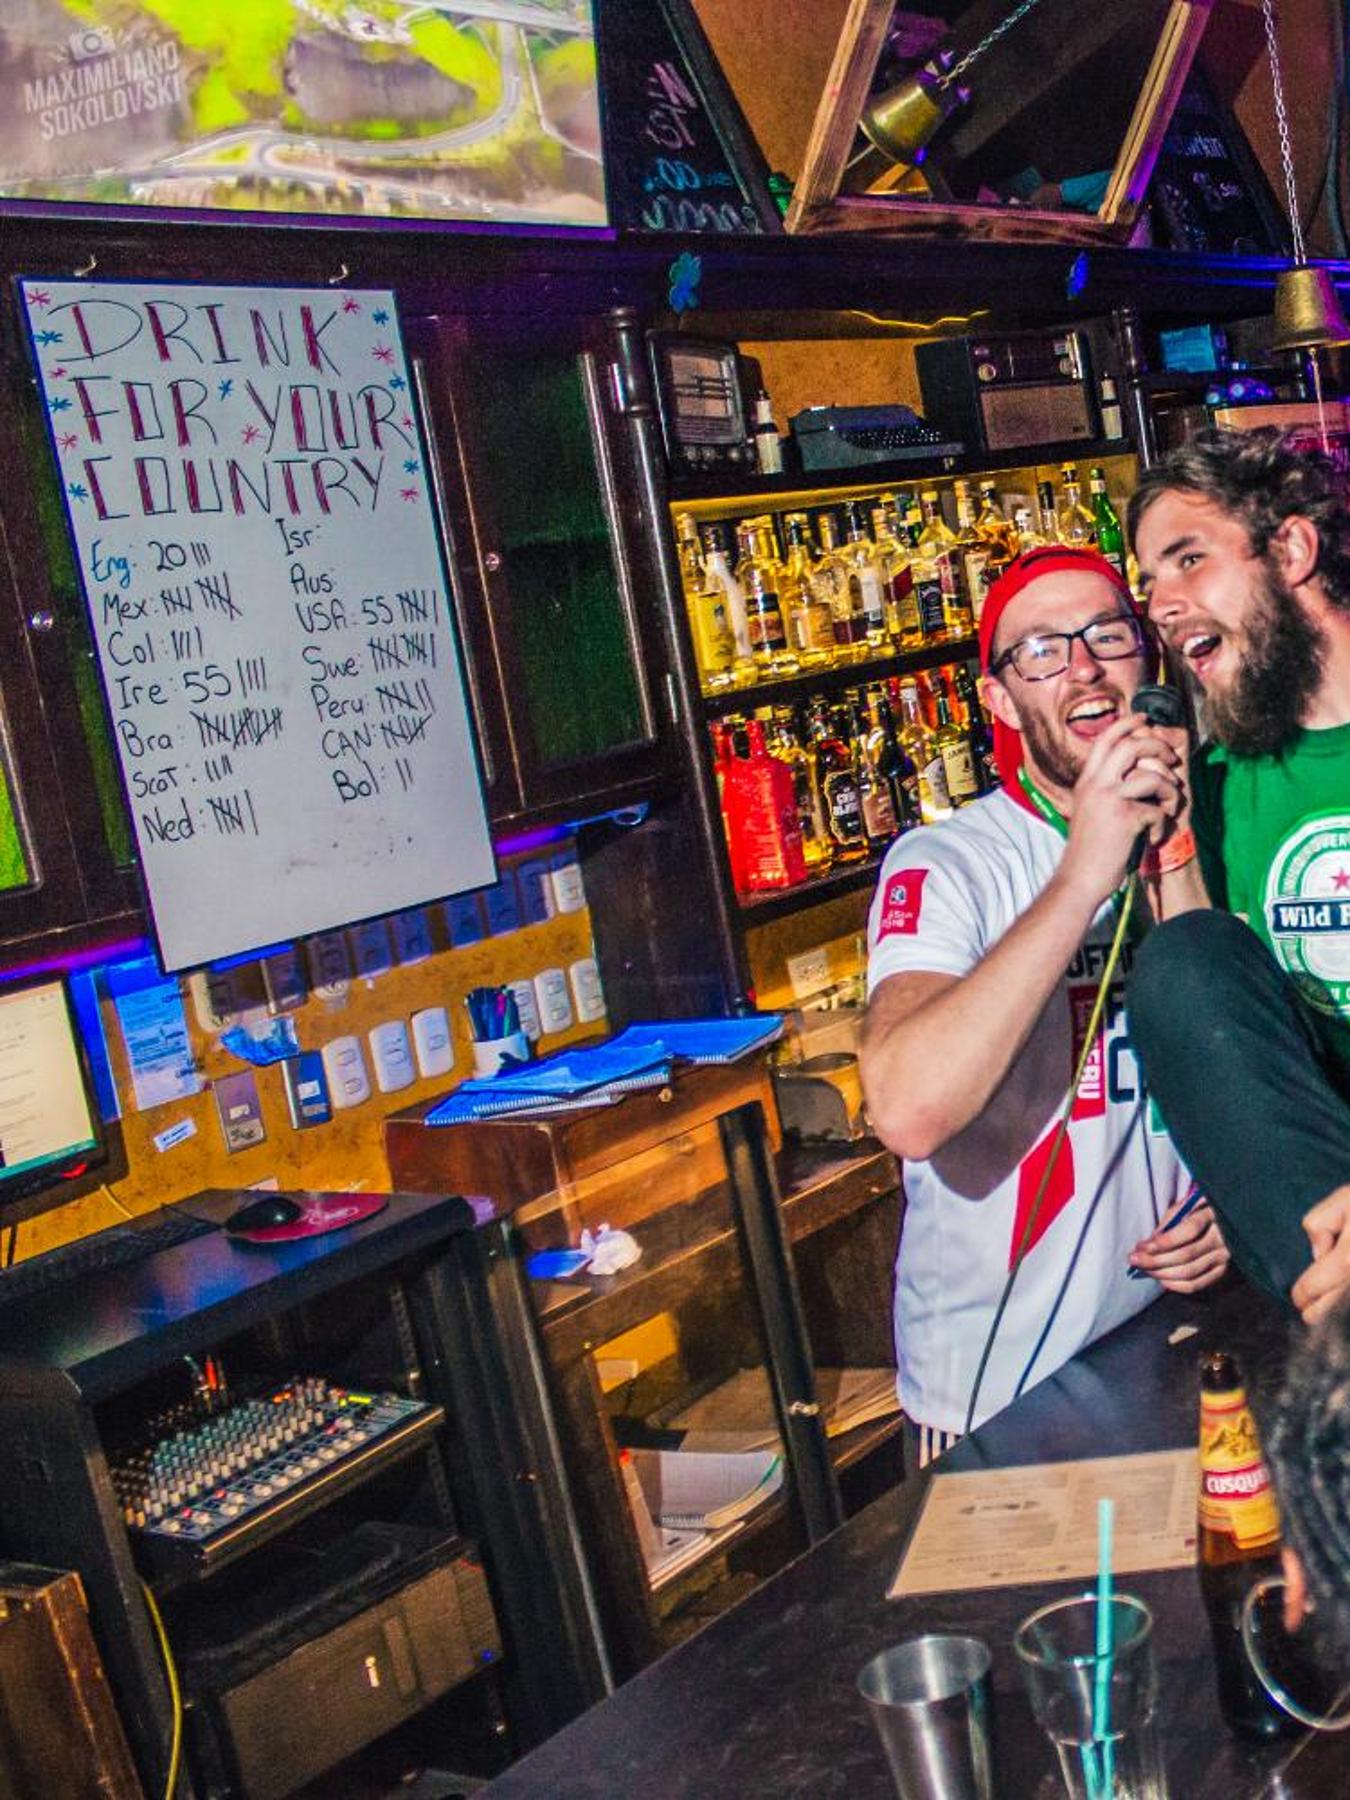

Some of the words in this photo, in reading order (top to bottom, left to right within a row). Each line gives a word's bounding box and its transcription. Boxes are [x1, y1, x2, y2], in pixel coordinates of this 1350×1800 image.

[24, 40, 179, 113] MAXIMILIANO
[40, 71, 182, 141] SOKOLOVSKI
[47, 299, 340, 375] DRINK
[69, 376, 219, 447] FOR
[246, 380, 415, 453] YOUR
[83, 456, 385, 520] COUNTRY
[1278, 905, 1332, 928] Wild
